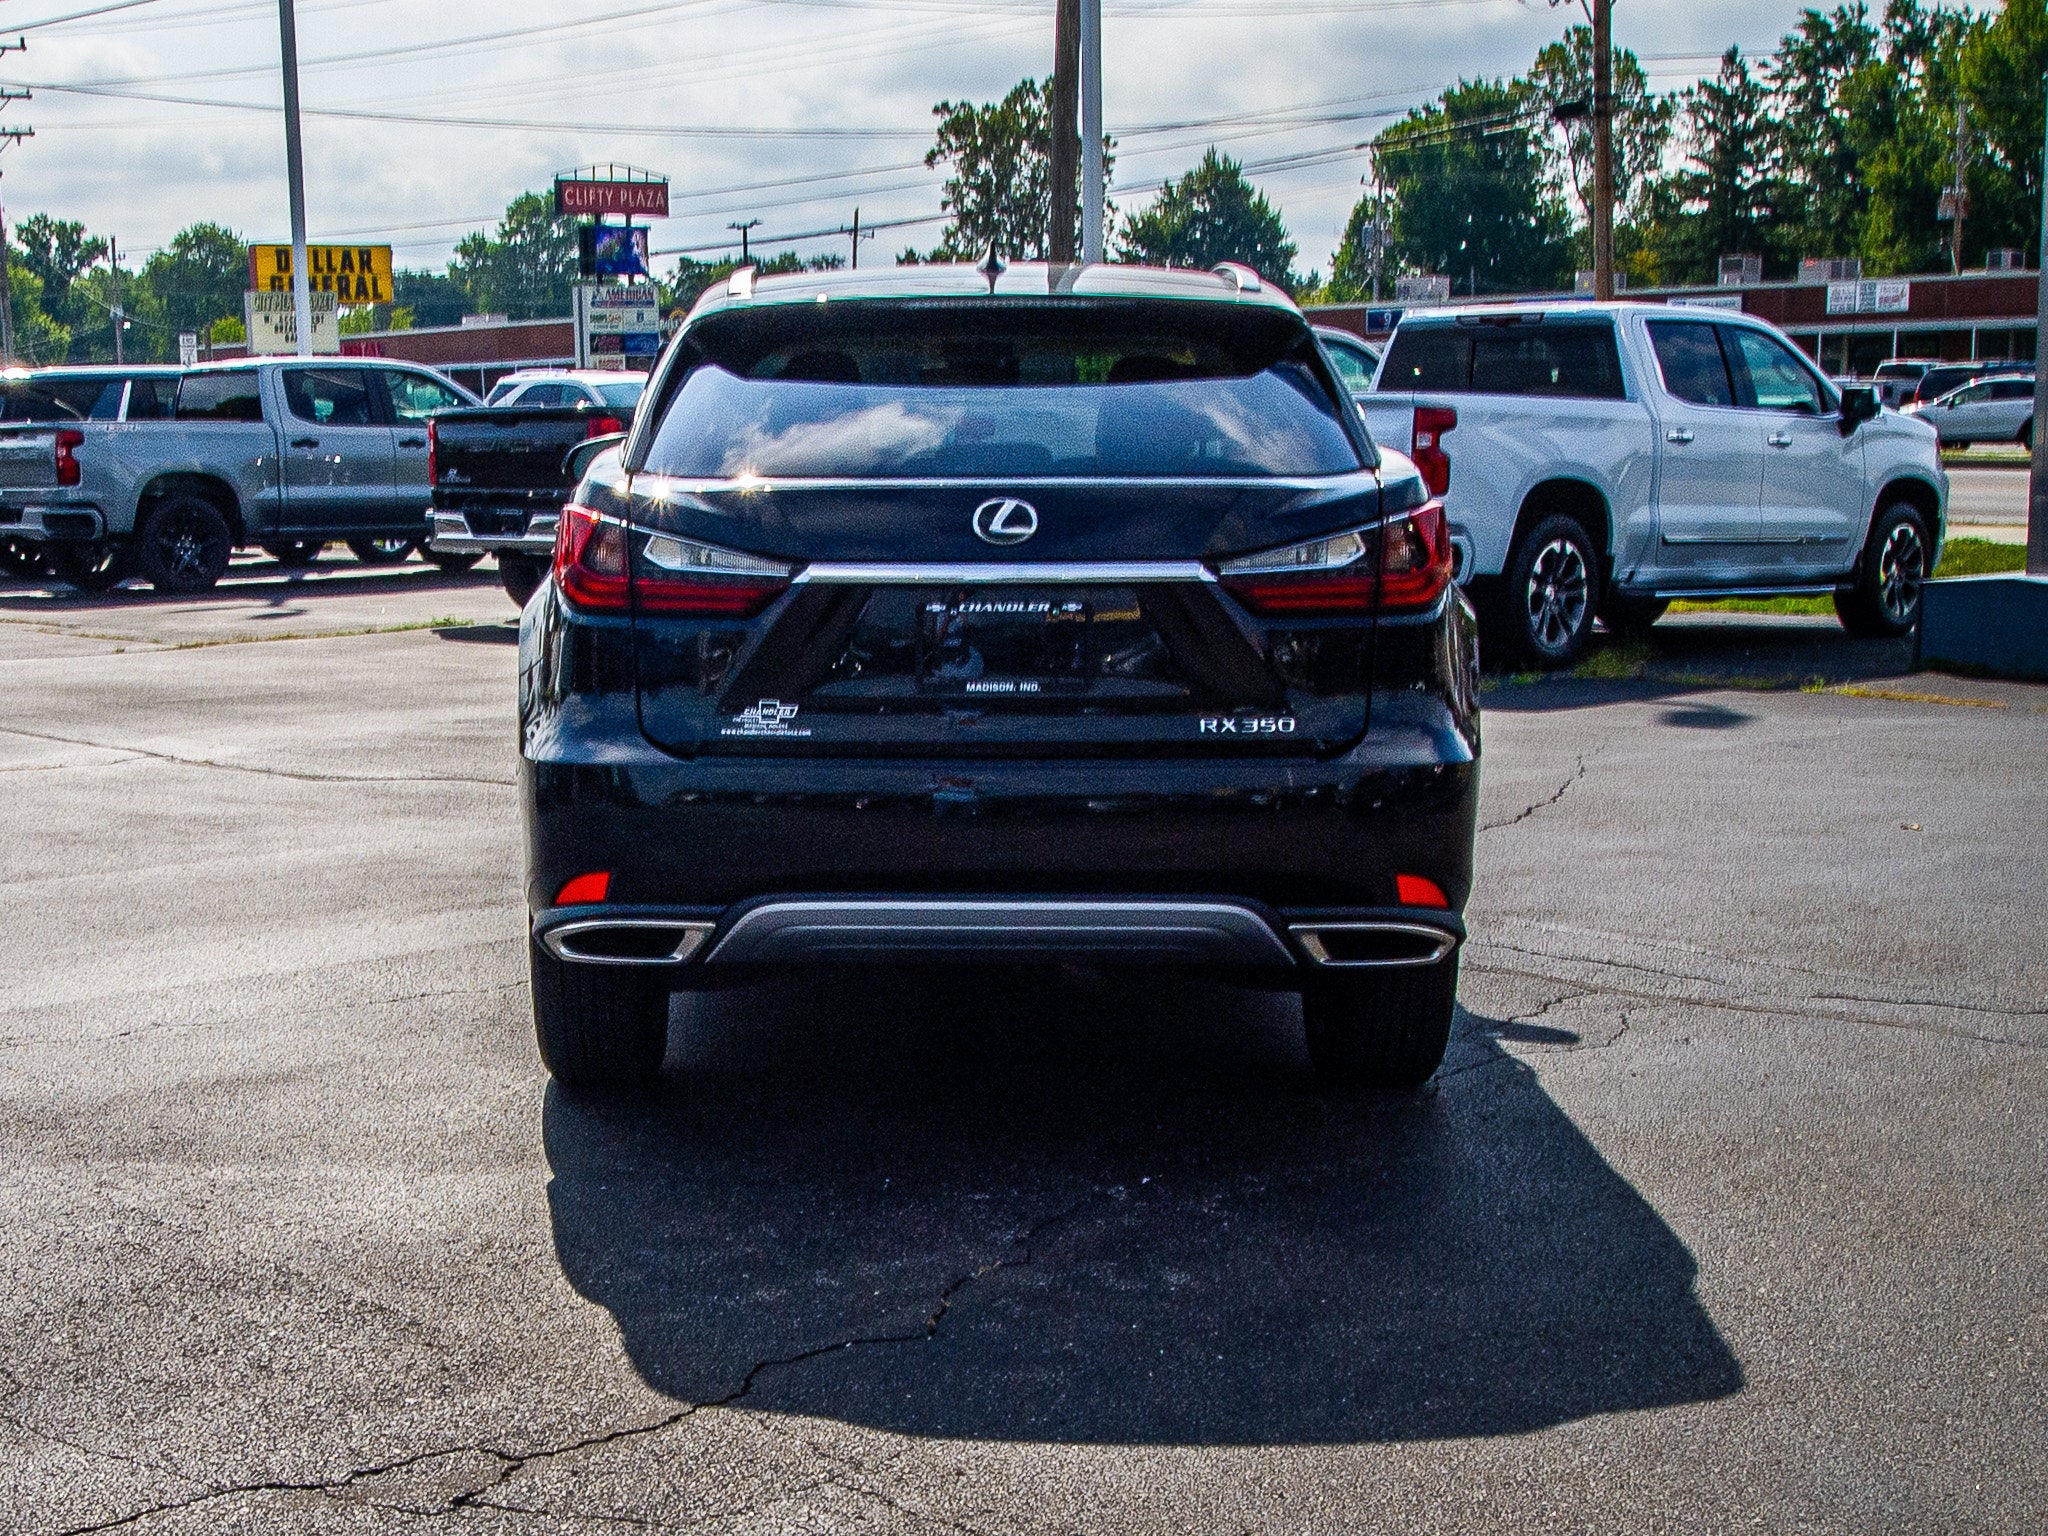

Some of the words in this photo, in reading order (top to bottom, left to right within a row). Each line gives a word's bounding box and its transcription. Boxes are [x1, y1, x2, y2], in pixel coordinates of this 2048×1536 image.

[564, 186, 614, 206] CLIFTY
[620, 188, 666, 209] PLAZA
[275, 247, 373, 273] DLLAR
[958, 602, 1050, 613] CHANDLER
[1019, 681, 1042, 693] IND.
[1200, 717, 1237, 734] RX
[1240, 717, 1296, 734] 350
